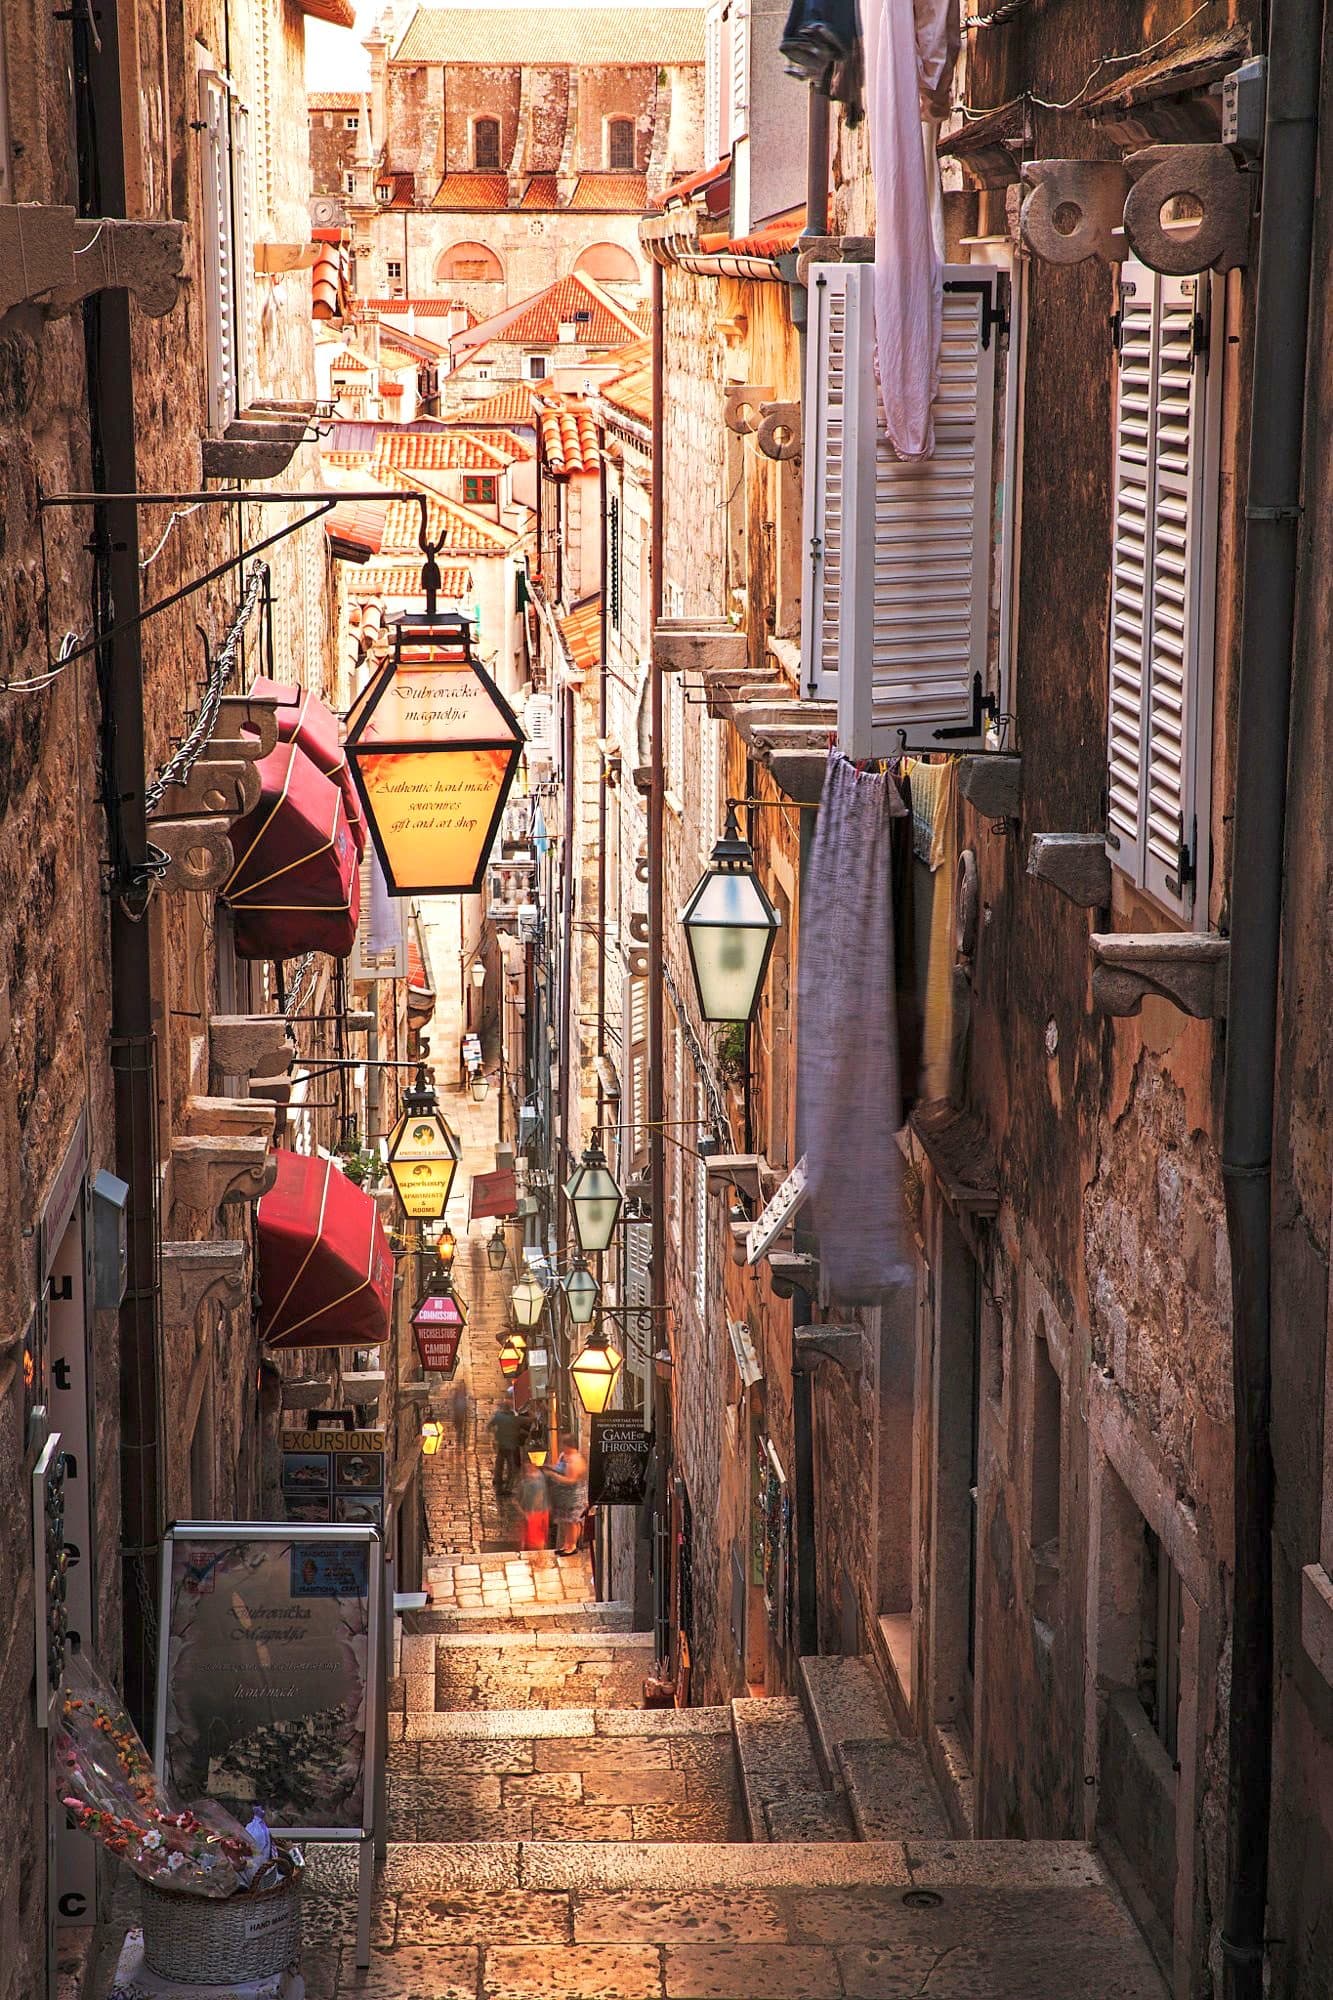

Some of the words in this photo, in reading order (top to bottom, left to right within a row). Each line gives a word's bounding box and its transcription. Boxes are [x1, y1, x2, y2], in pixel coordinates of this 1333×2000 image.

[391, 684, 479, 699] Dubrovačka
[404, 707, 467, 725] magnolija
[375, 781, 432, 794] Authentic
[434, 781, 462, 793] hand
[464, 781, 494, 793] made
[391, 817, 410, 834] gift
[411, 818, 434, 830] and
[436, 819, 453, 829] art
[455, 816, 478, 832] shop
[419, 1310, 458, 1321] COMMISSION
[424, 1344, 451, 1354] CAMBIO
[427, 1355, 449, 1366] VALUTE
[282, 1432, 383, 1451] EXCURSIONS
[602, 1429, 637, 1441] GAME
[599, 1440, 649, 1453] THRONES
